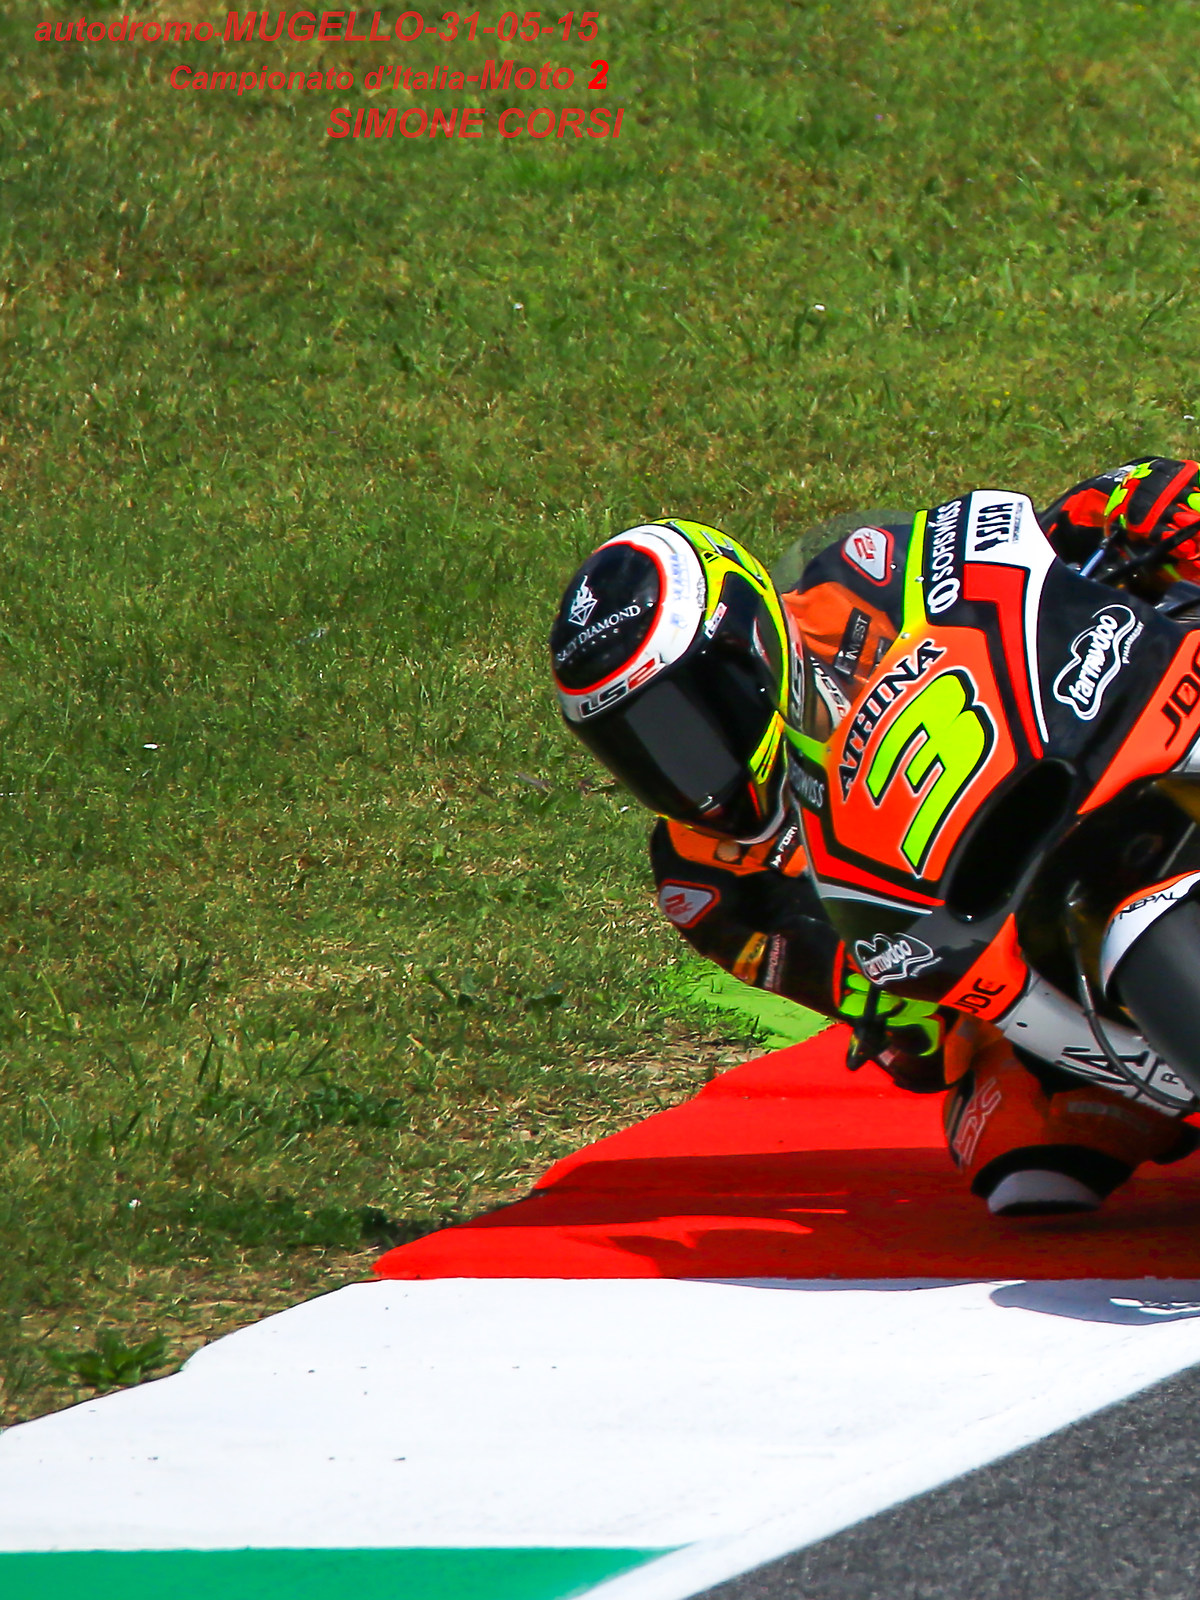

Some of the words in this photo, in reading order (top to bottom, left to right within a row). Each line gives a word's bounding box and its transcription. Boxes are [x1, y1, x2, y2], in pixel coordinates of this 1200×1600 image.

[976, 503, 1013, 537] SISA
[579, 604, 641, 644] DIAMOND
[579, 657, 661, 718] LS2
[838, 638, 946, 803] ATHINA
[865, 666, 997, 879] 3
